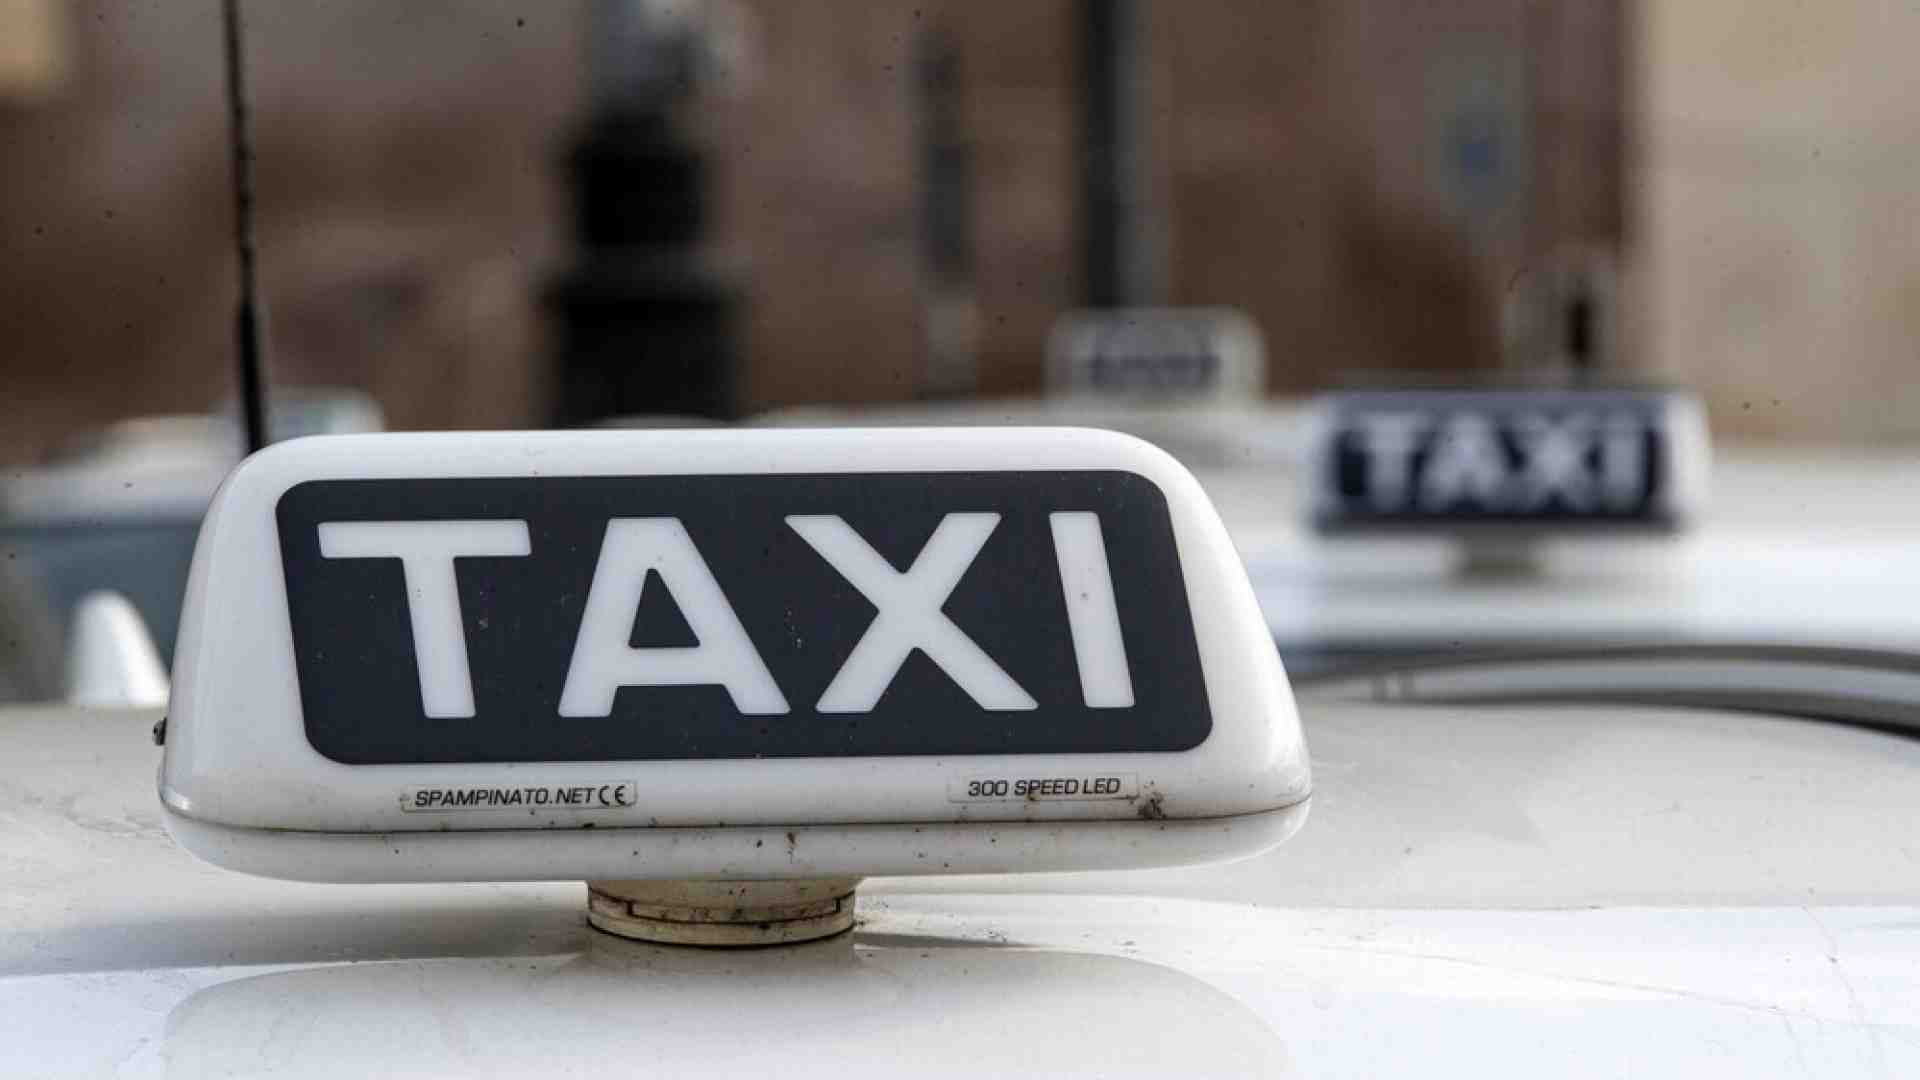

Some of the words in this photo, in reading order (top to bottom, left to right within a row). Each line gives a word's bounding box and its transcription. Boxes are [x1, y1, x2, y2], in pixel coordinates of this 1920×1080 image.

[1358, 410, 1650, 510] TAXI
[317, 510, 1136, 719] TAXI
[414, 787, 597, 807] SPAMPINATO.NET
[968, 780, 1008, 797] 300
[1014, 779, 1079, 796] SPEED
[1083, 778, 1121, 795] LED
